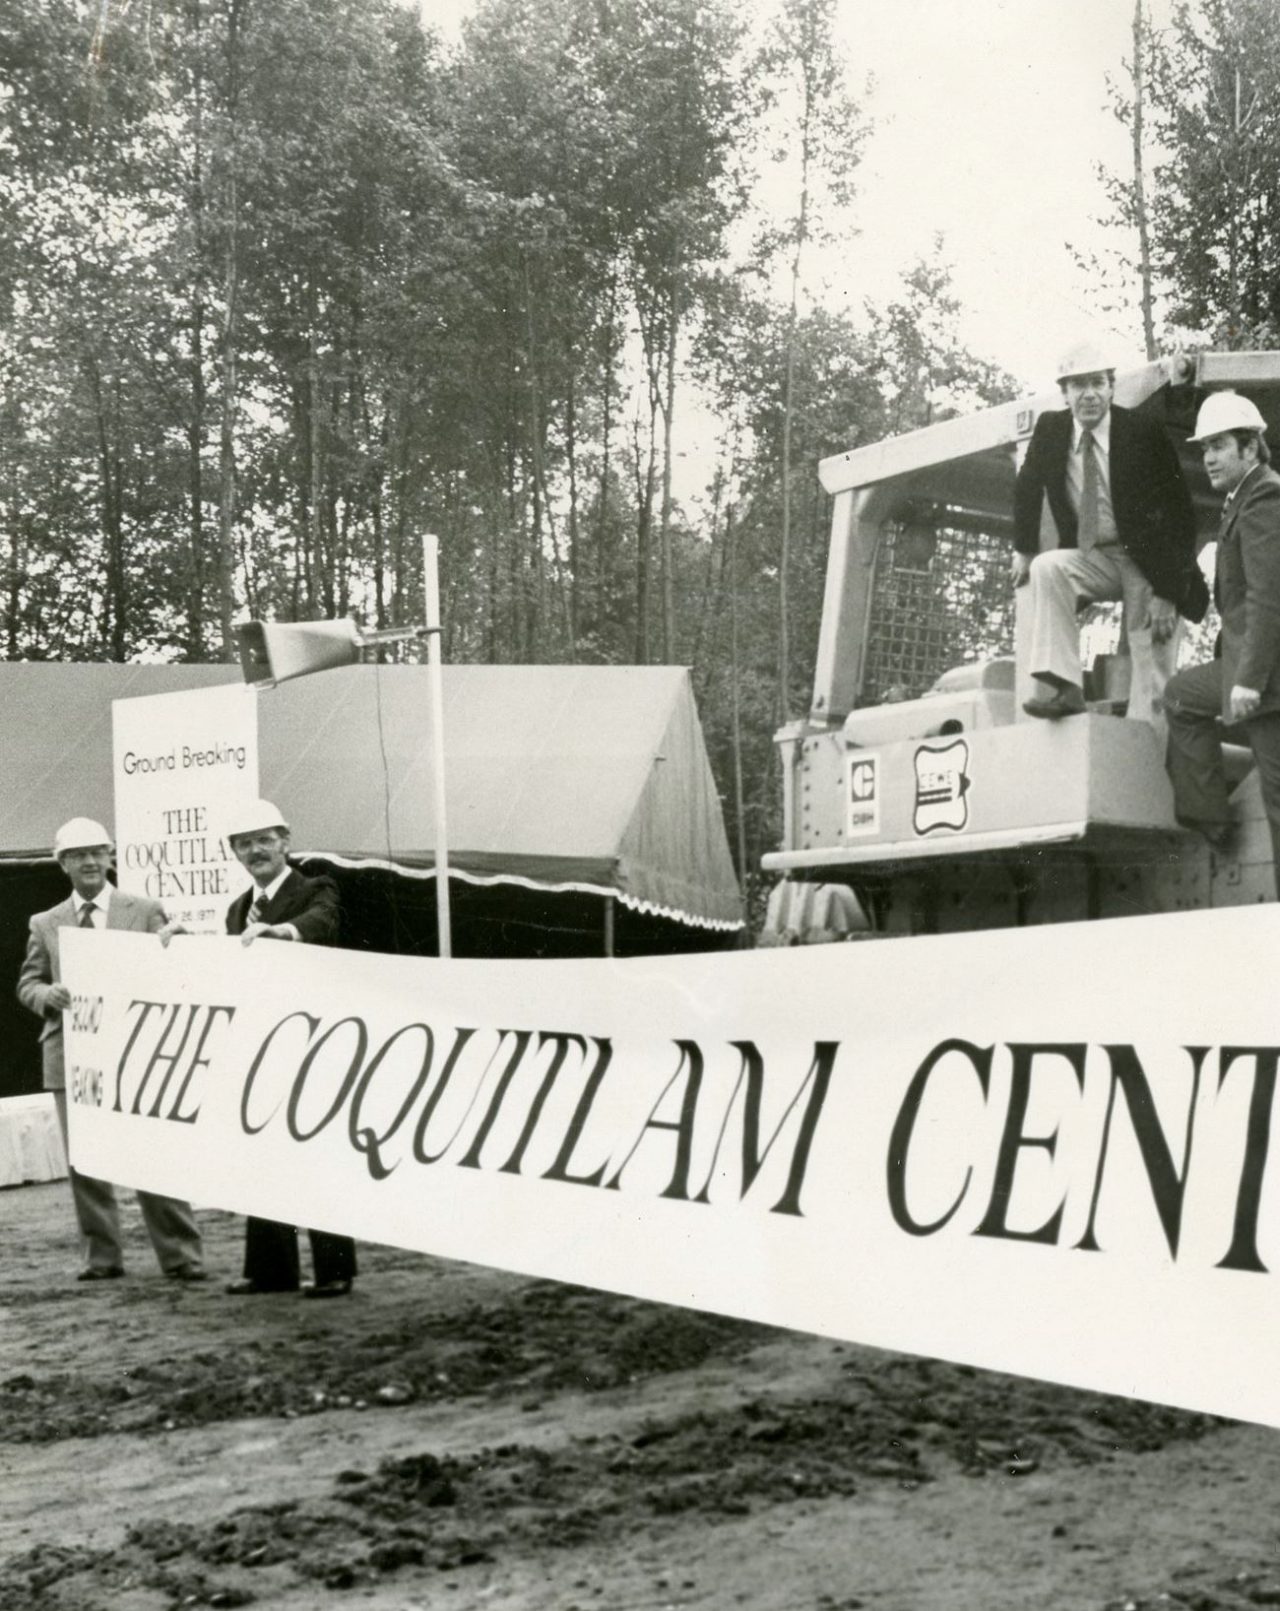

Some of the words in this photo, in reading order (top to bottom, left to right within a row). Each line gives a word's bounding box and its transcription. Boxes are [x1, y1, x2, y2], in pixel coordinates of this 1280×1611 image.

[123, 747, 176, 775] Ground
[182, 742, 246, 770] Breaking
[162, 806, 208, 835] THE
[125, 837, 234, 873] COQUITLA
[145, 868, 229, 898] CENTRE
[112, 999, 236, 1124] THE
[241, 1012, 842, 1217] COQUITLAM
